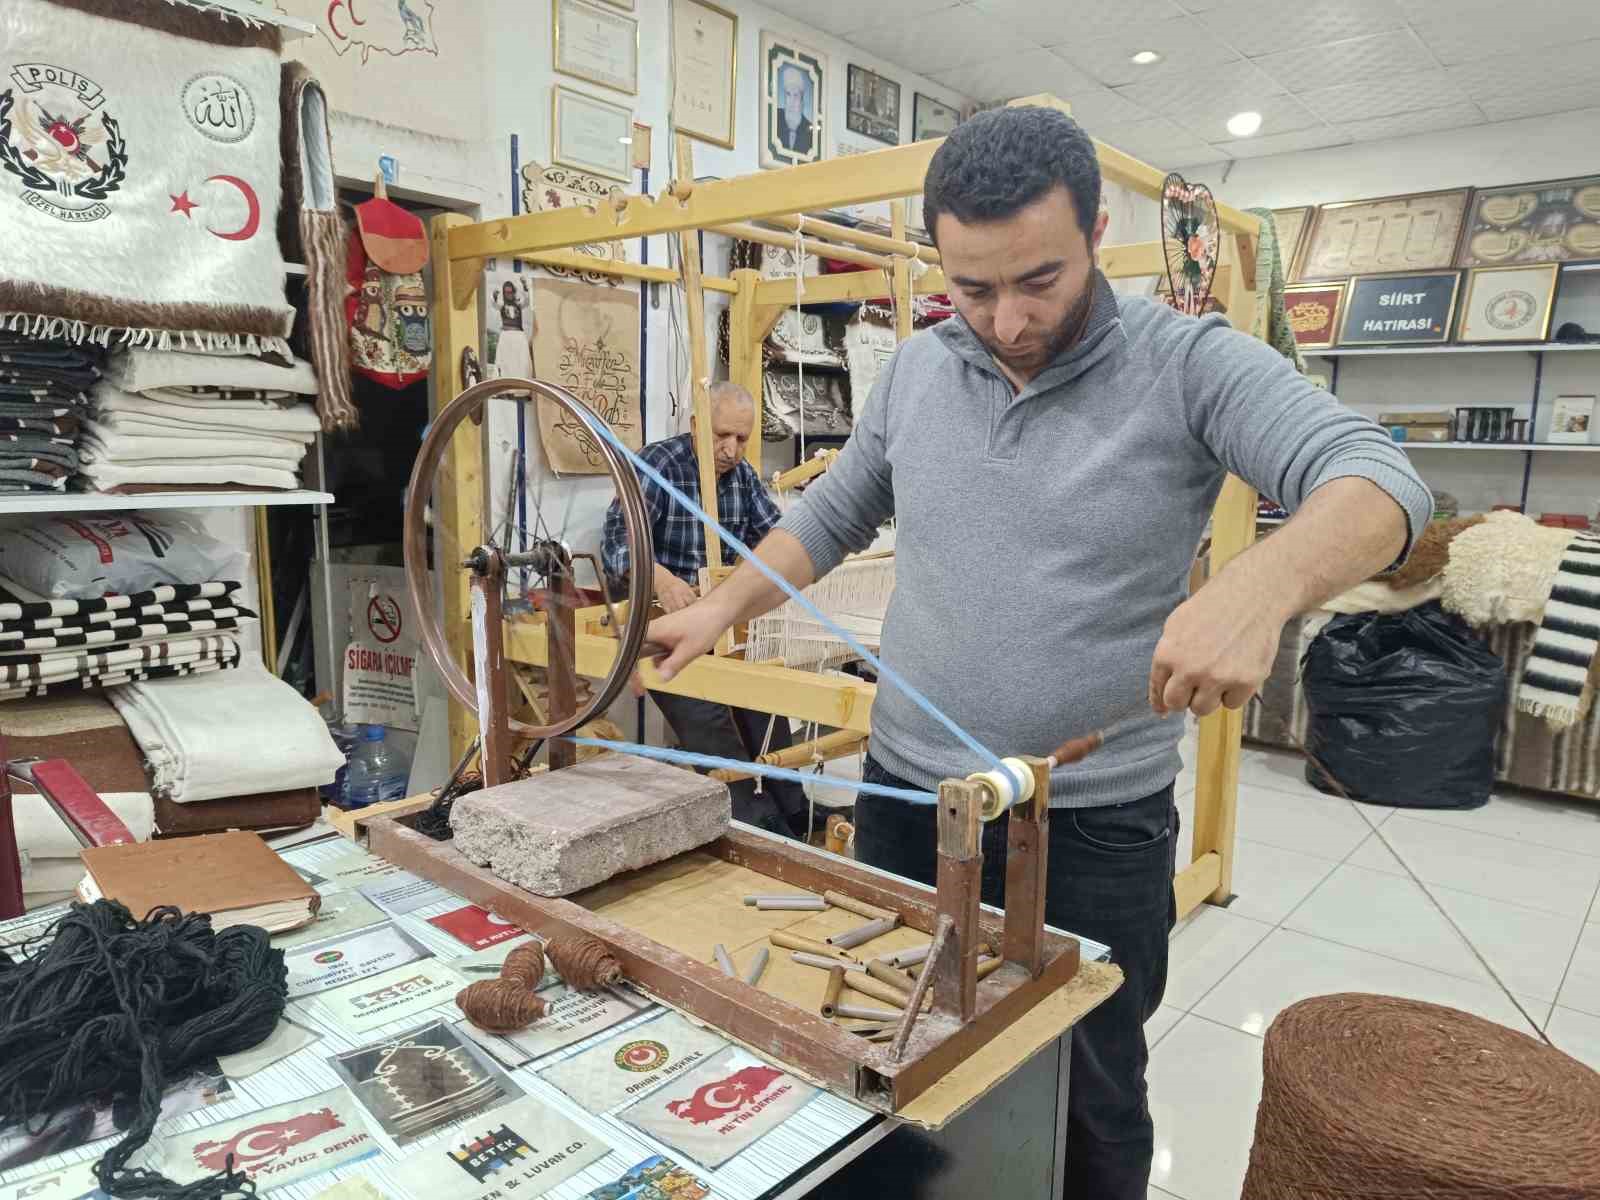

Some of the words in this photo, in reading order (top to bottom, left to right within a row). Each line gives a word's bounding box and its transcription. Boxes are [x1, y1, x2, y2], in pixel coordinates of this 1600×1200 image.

[1362, 319, 1433, 332] HATIRASI
[348, 643, 383, 673] SİGARA
[468, 1138, 518, 1168] BETEK
